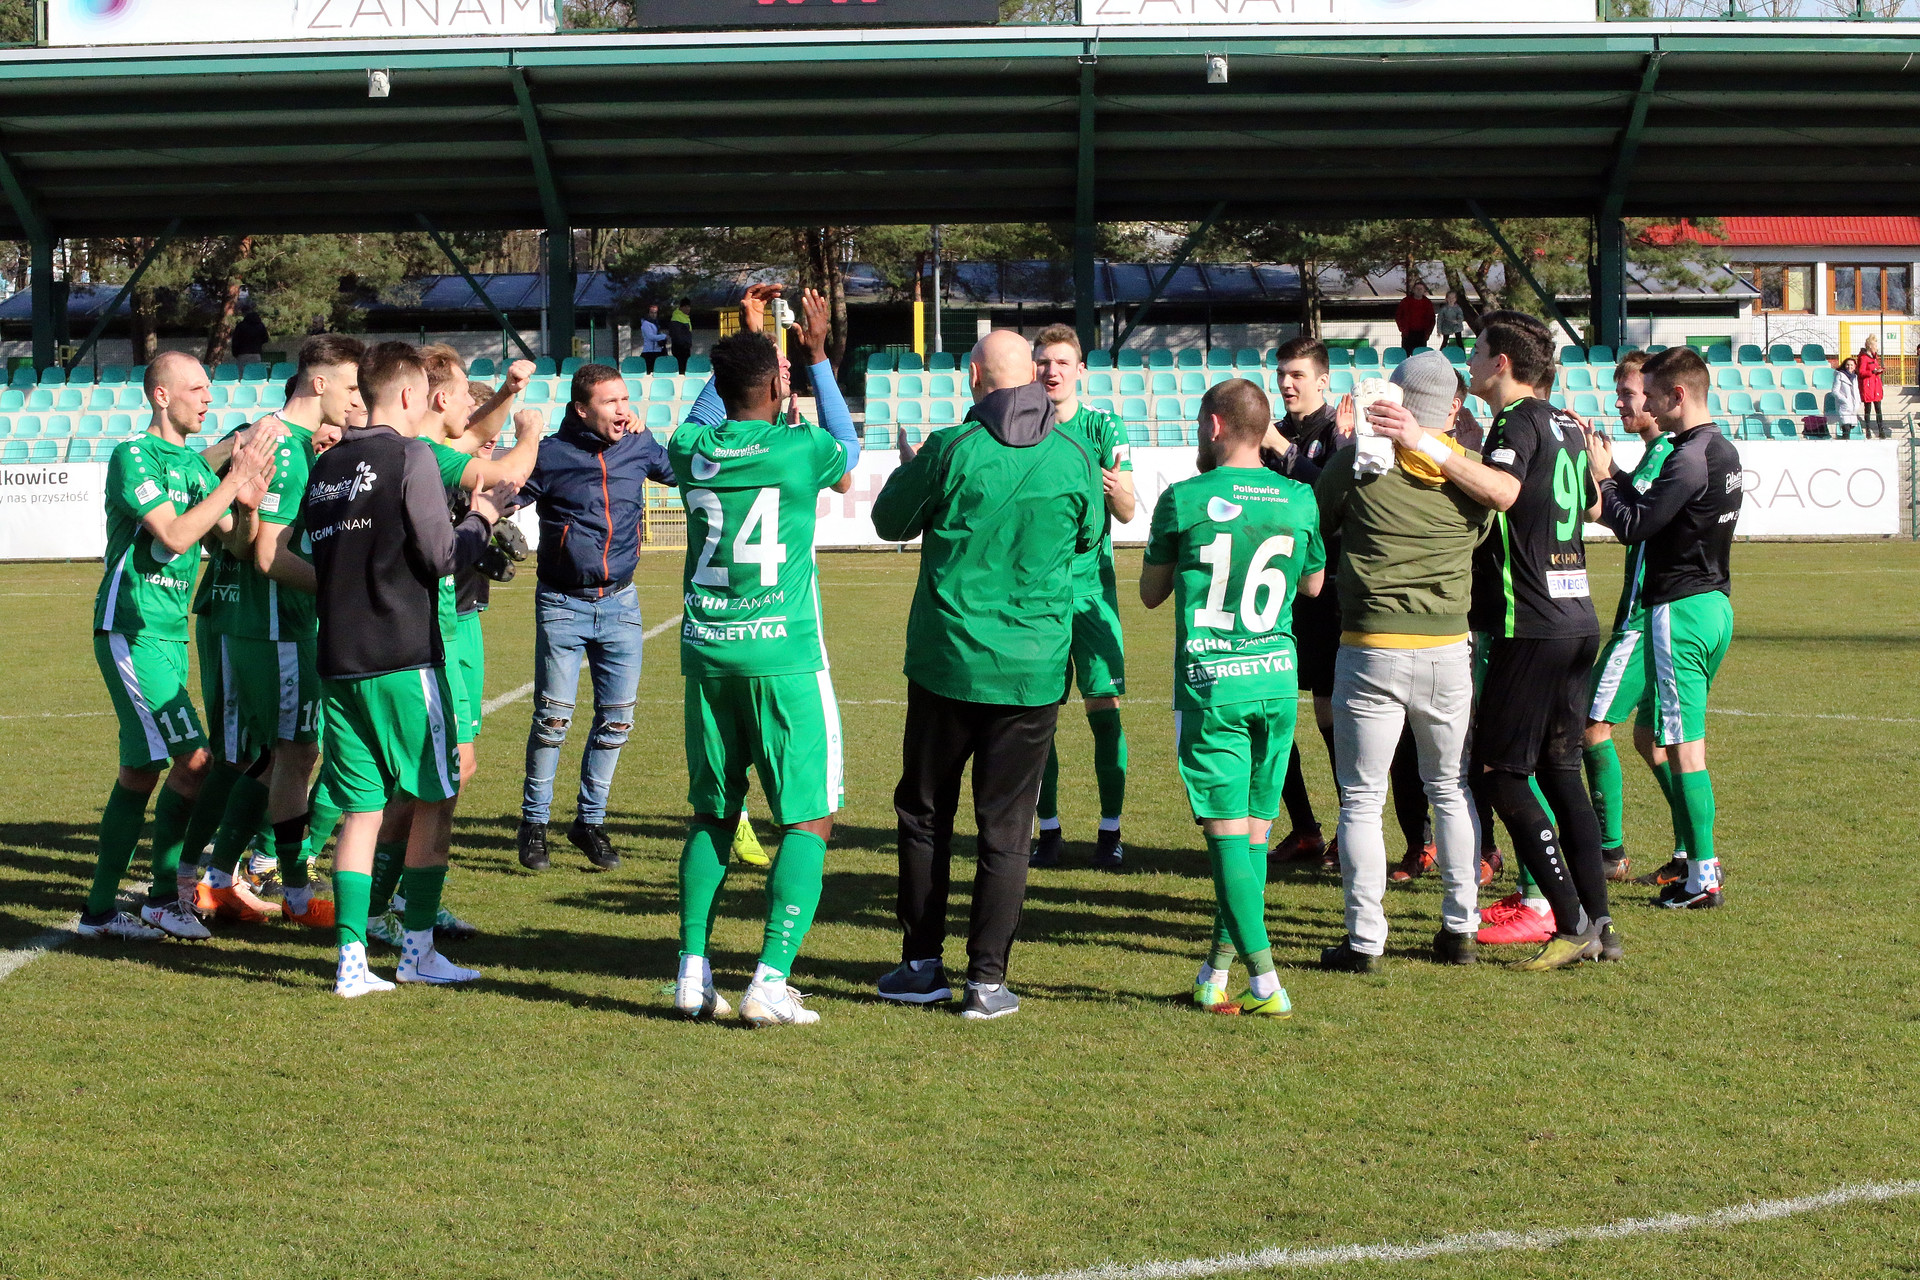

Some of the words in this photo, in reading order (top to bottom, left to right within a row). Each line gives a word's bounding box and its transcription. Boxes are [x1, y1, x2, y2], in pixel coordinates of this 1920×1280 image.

[7, 494, 27, 503] nas
[31, 491, 89, 504] przyszłość
[1233, 484, 1280, 495] Polkowice
[686, 487, 788, 587] 24
[1194, 533, 1295, 633] 16
[684, 592, 728, 610] KGHM
[730, 590, 784, 610] ZANAM
[683, 617, 788, 641] ENERGETYKA
[1185, 638, 1232, 653] KGHM
[1187, 655, 1294, 682] ENERGETYKA
[159, 706, 199, 744] 11
